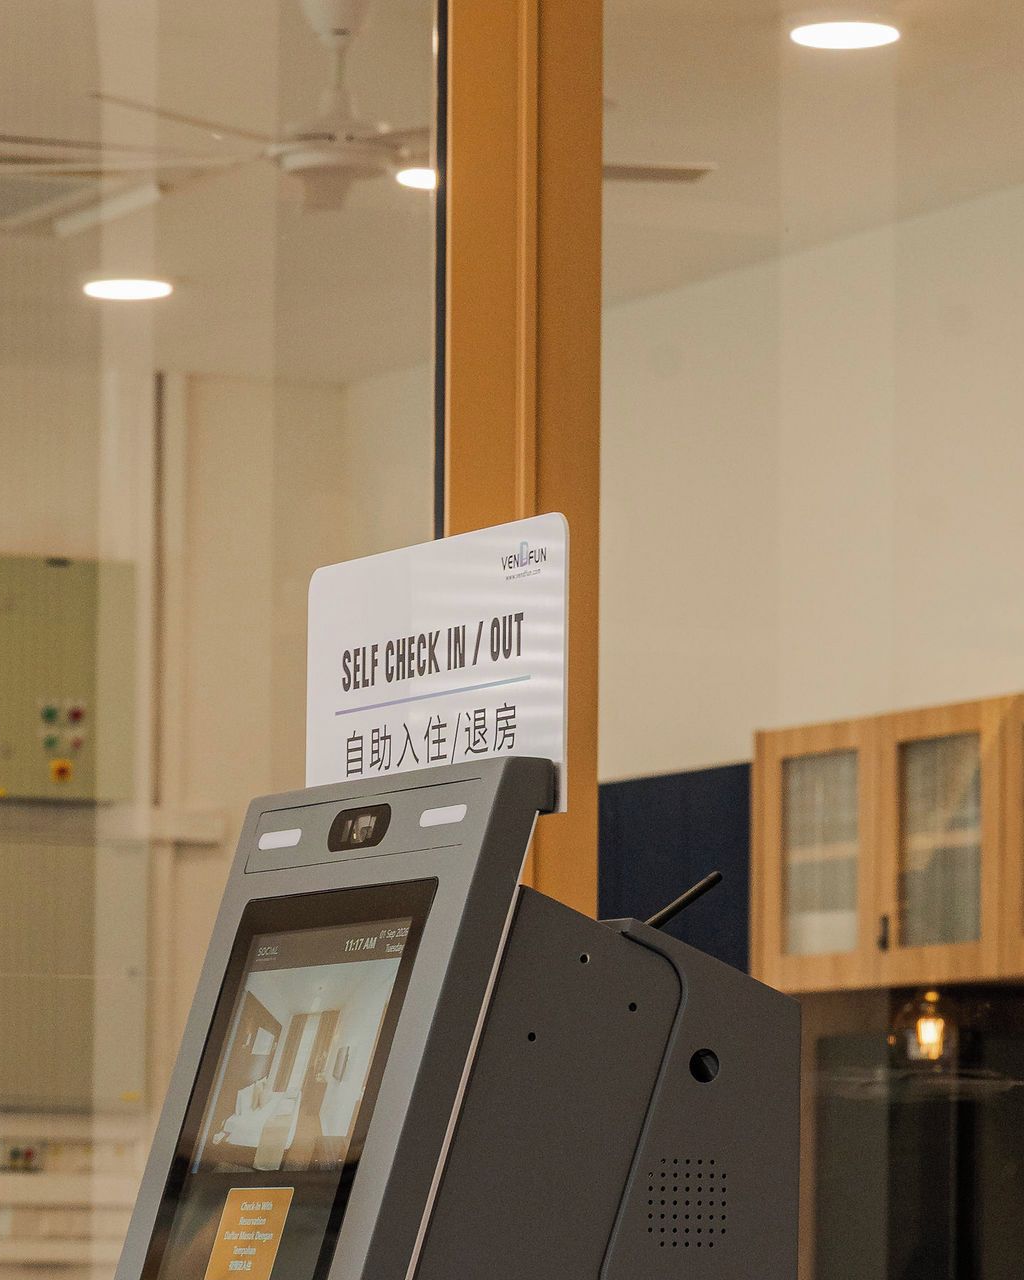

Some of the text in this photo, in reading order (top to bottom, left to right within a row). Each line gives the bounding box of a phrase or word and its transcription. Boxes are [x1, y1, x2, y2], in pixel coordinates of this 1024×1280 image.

[342, 612, 524, 692] SELF CHECK IN / OUT
[346, 702, 517, 777] 自助入住/退房
[344, 937, 377, 951] 11:17 AM
